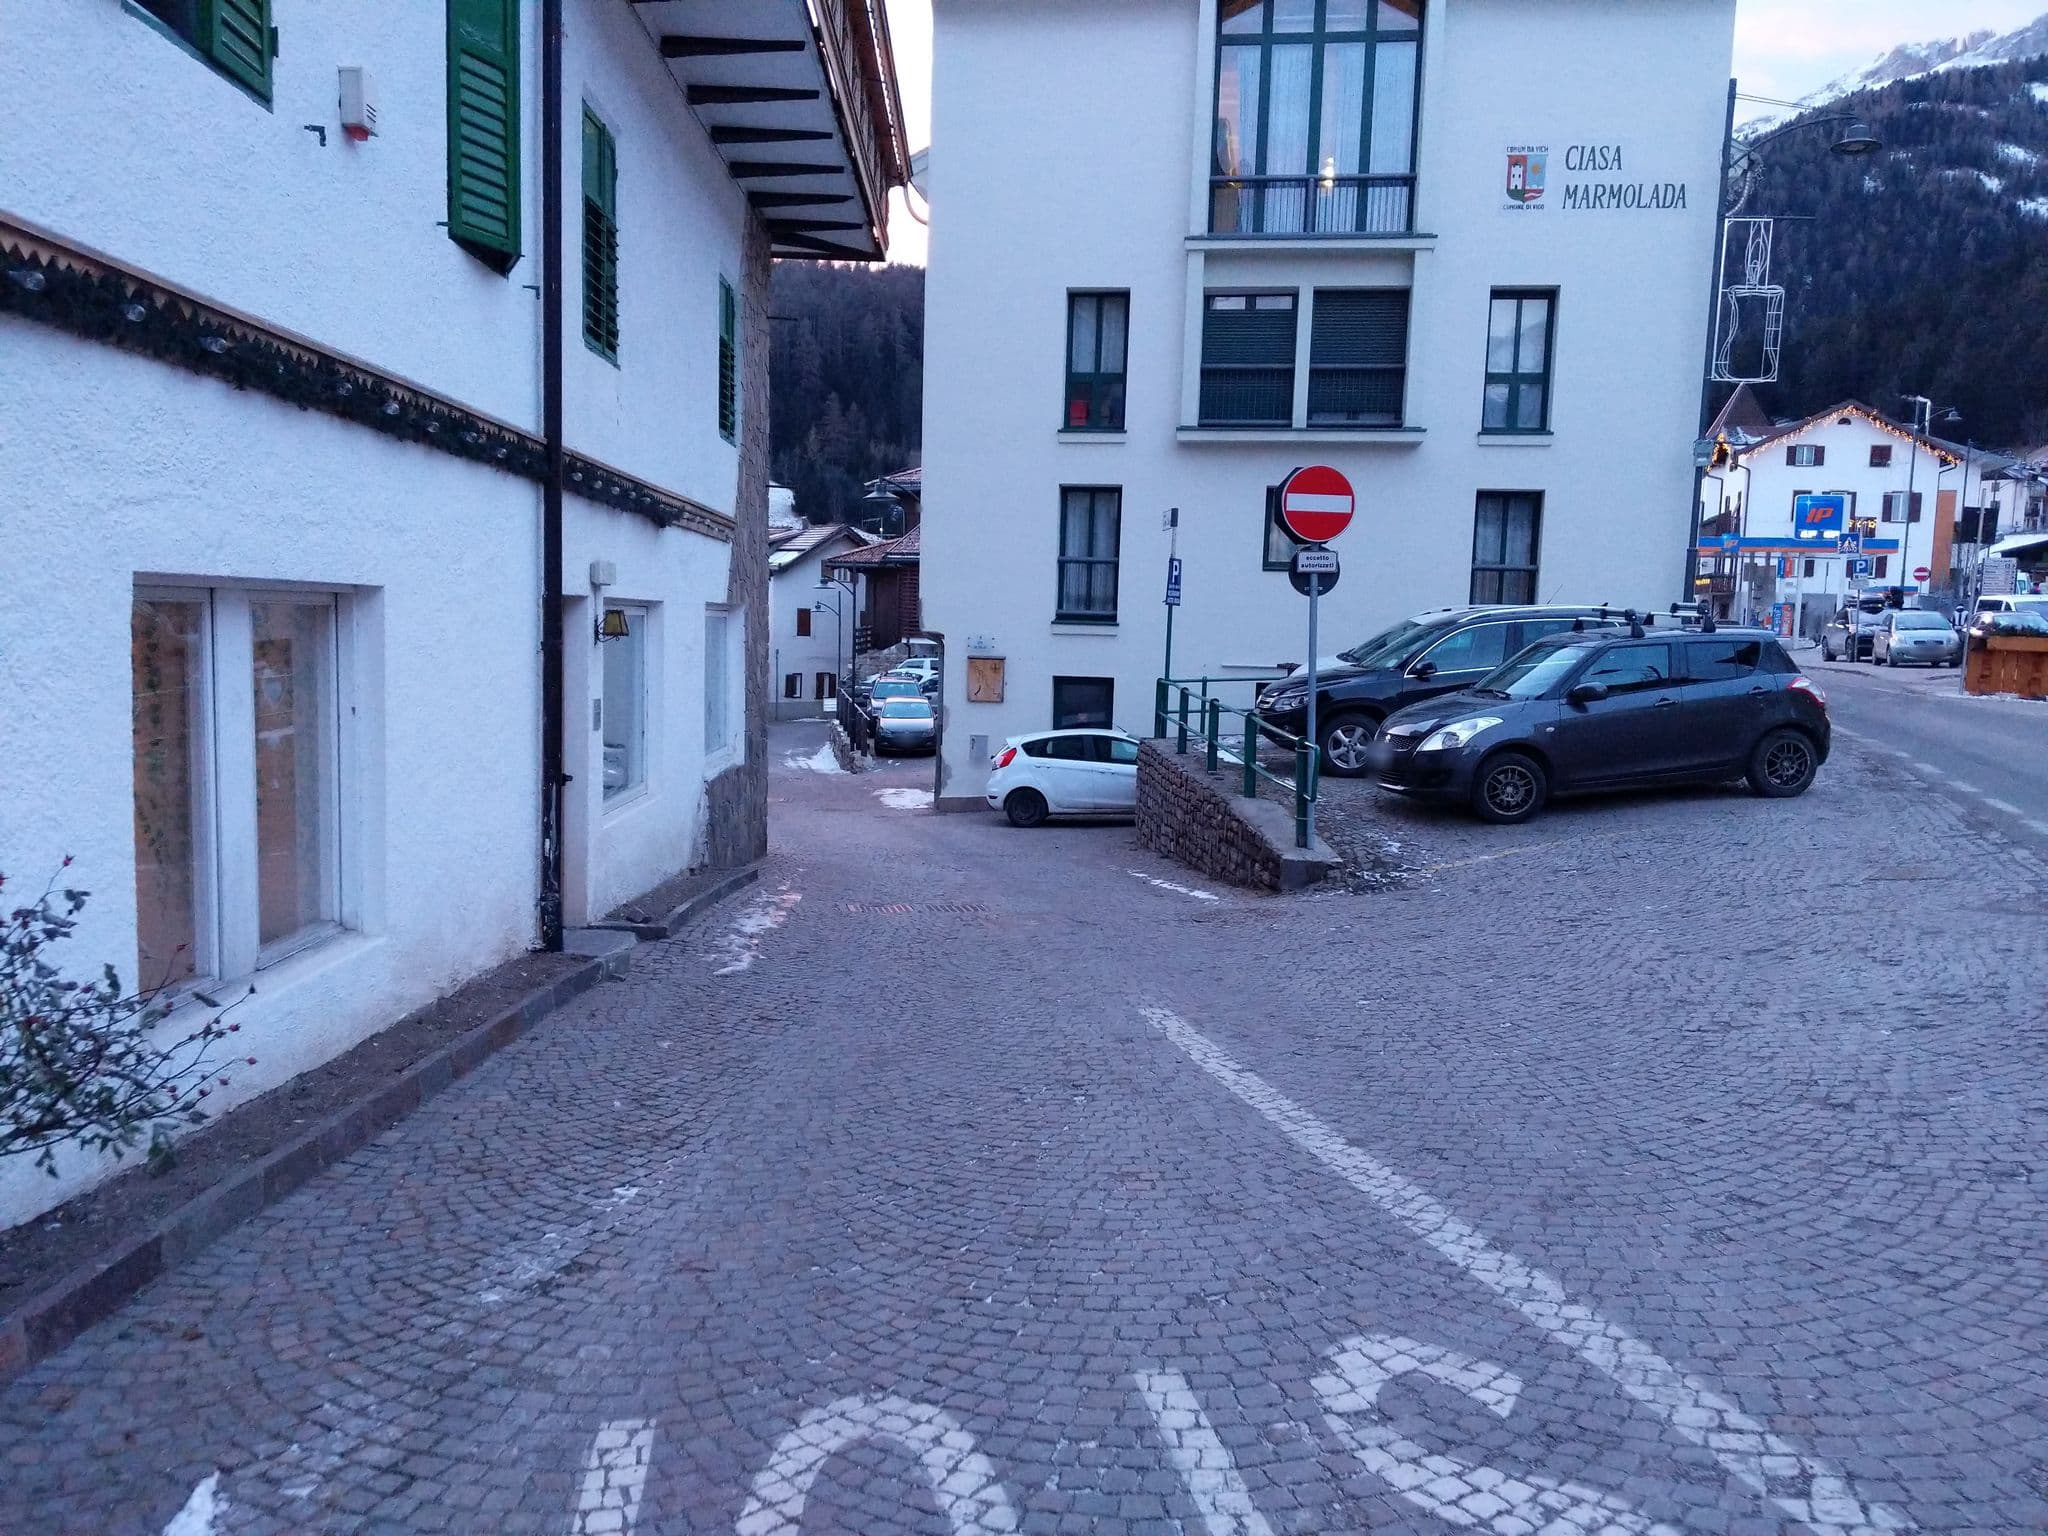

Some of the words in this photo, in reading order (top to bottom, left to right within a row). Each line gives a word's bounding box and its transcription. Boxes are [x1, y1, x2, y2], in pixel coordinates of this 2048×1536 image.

[1565, 145, 1623, 171] CIASA
[1562, 183, 1687, 210] MARMOLADA
[1172, 560, 1180, 583] P
[1856, 561, 1866, 572] P
